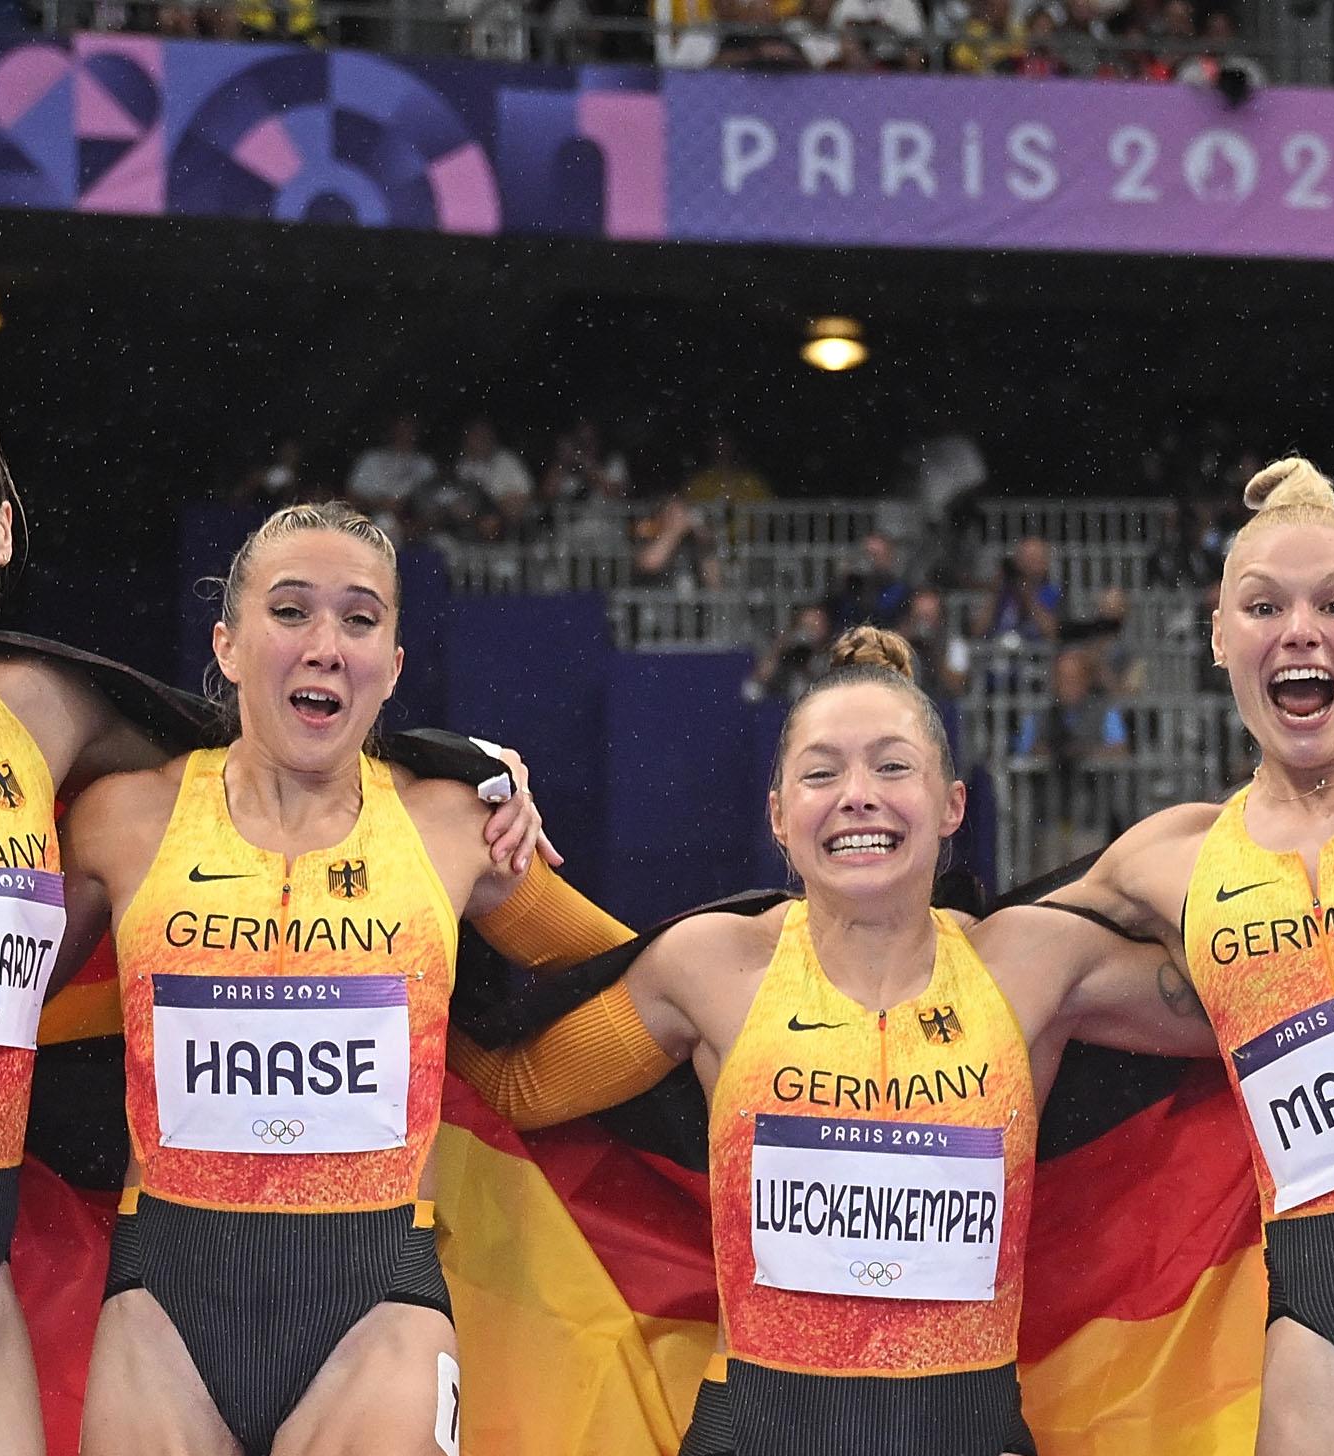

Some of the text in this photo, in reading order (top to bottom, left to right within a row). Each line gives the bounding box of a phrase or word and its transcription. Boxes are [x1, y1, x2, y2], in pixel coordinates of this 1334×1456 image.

[720, 116, 1060, 200] PARIS
[165, 910, 401, 955] GERMANY
[212, 985, 341, 1001] PARIS 2024
[1274, 1011, 1328, 1047] PARIS
[185, 1039, 378, 1096] HAASE
[772, 1062, 989, 1112] GERMANY
[821, 1125, 948, 1147] PARIS 2024
[755, 1179, 997, 1244] LUECKENKEMPER
